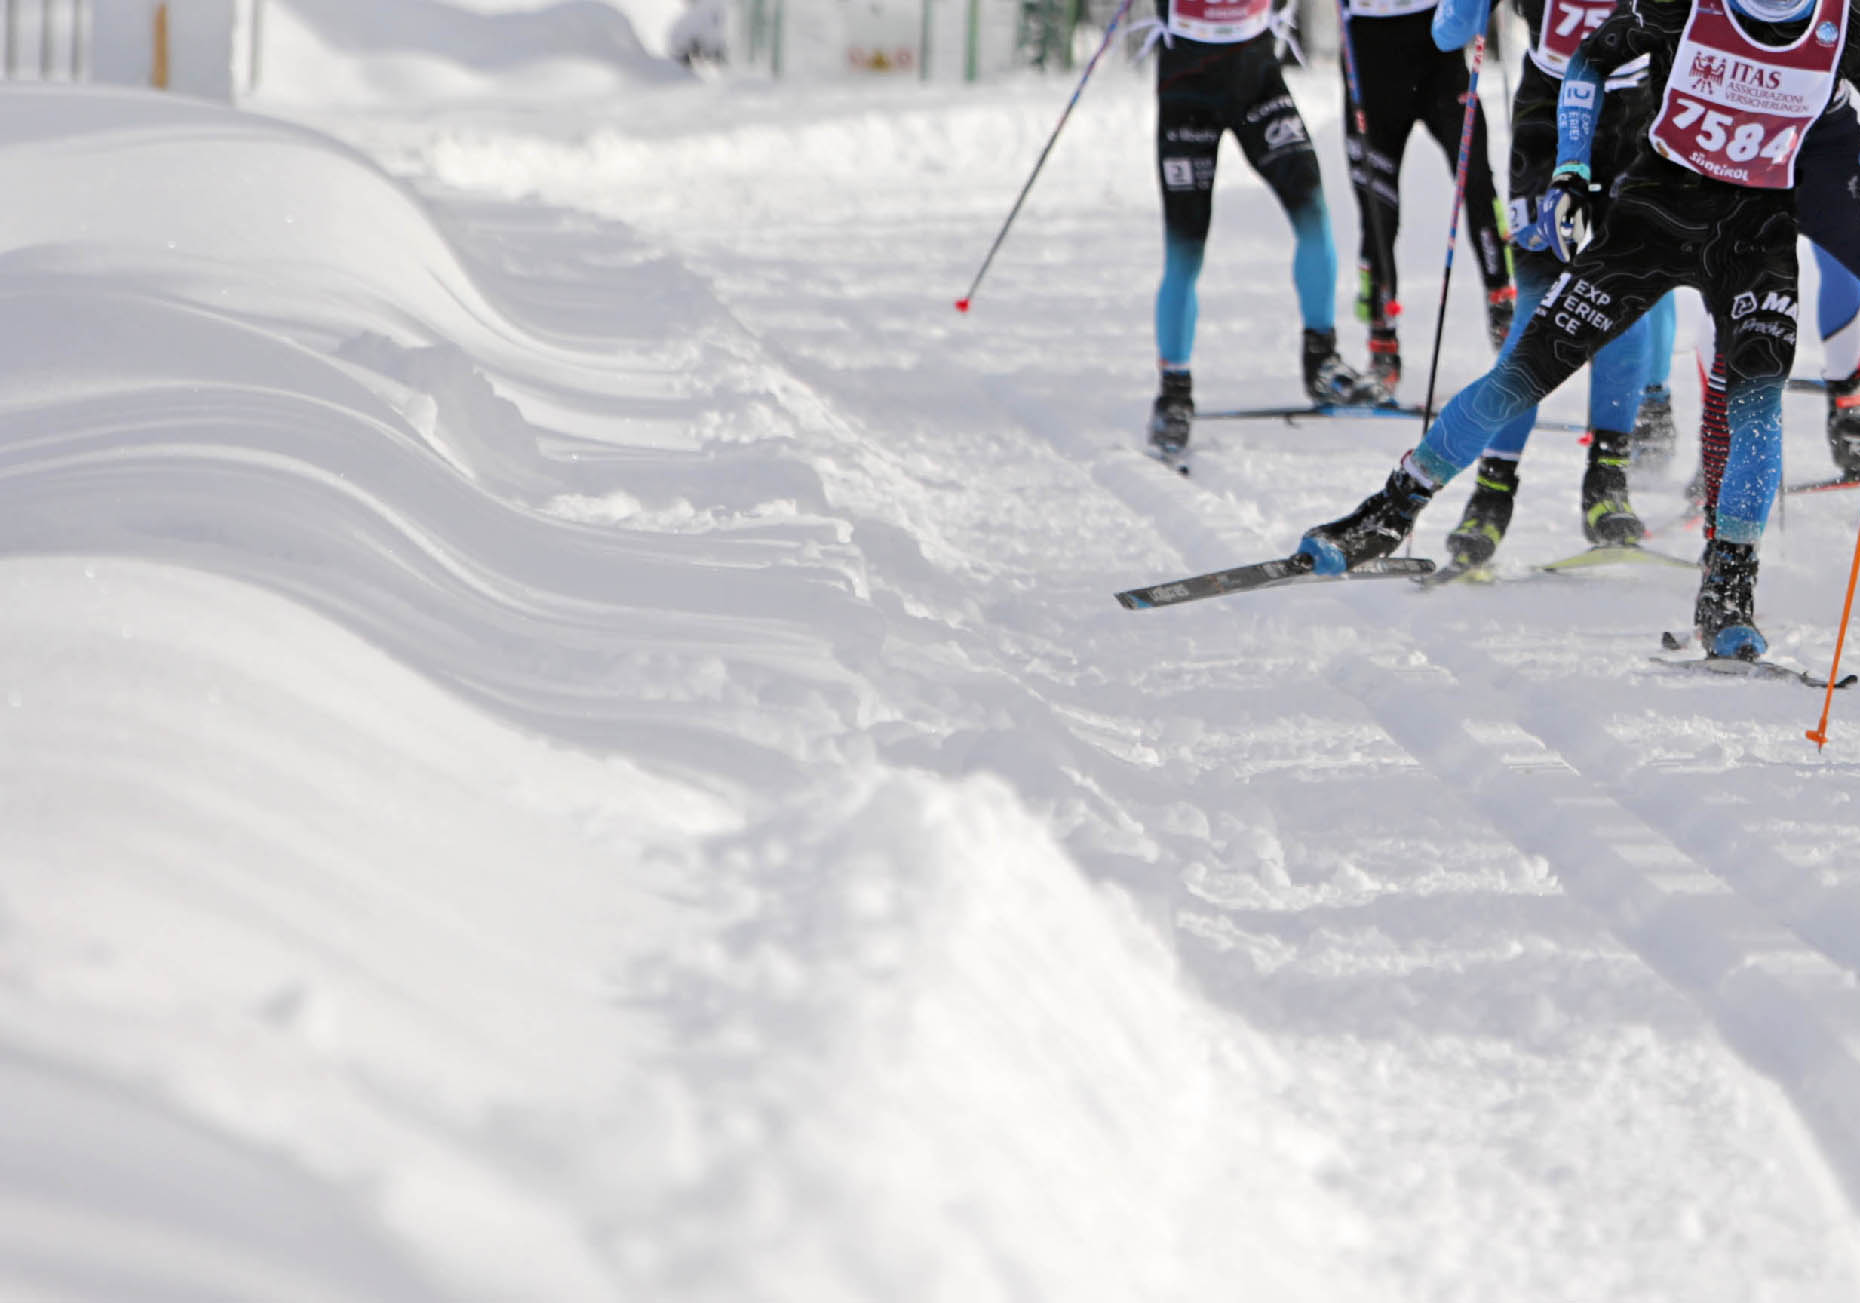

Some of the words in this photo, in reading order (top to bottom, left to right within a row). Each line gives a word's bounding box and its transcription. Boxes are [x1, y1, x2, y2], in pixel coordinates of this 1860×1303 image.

[1730, 61, 1782, 90] ITAS
[1672, 97, 1797, 165] 7584
[1573, 279, 1611, 307] EXP
[1554, 312, 1581, 336] CE
[1563, 295, 1614, 332] ERIEN
